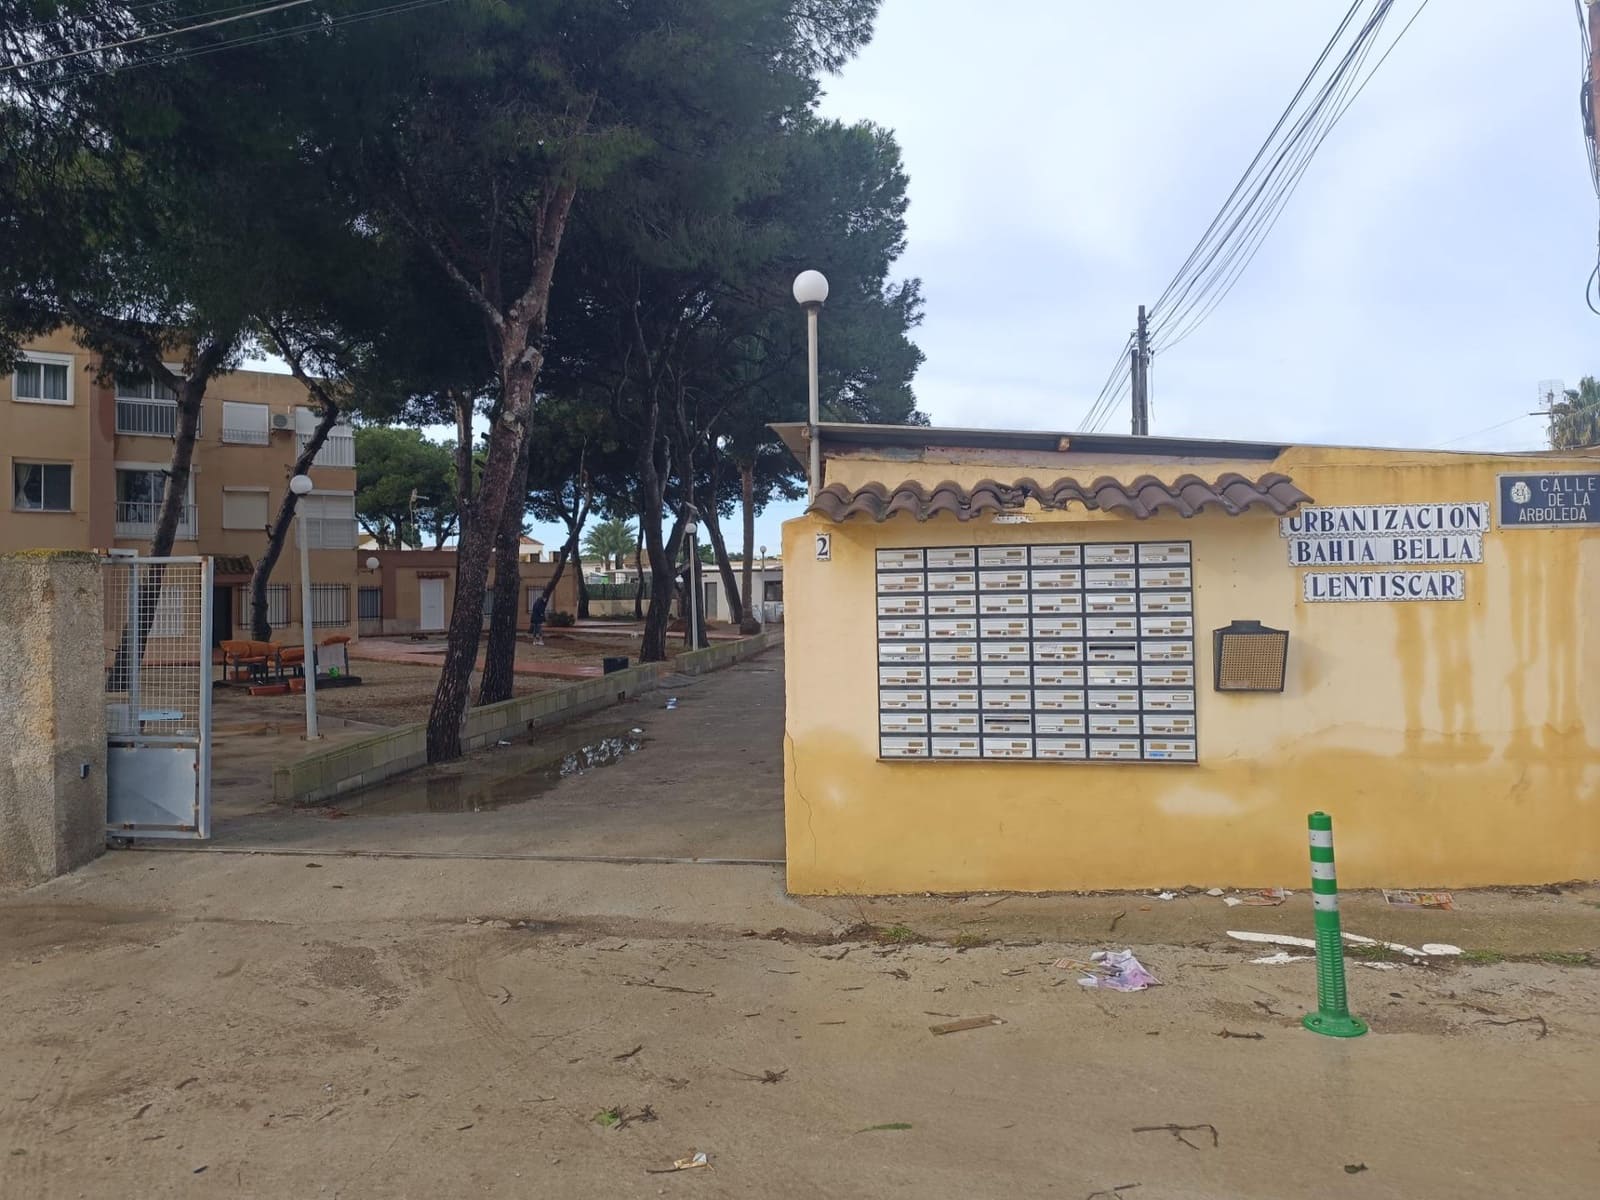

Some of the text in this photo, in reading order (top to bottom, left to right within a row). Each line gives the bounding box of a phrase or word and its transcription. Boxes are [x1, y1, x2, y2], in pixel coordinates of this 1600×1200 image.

[1540, 478, 1597, 492] CALLE
[1548, 492, 1591, 507] DE LA
[1289, 506, 1480, 532] URBANIZACION
[1519, 507, 1587, 522] ARBOLEDA
[816, 537, 828, 556] 2
[1297, 538, 1473, 562] BAHIA BELLA
[1312, 575, 1455, 597] LENTISCAR
